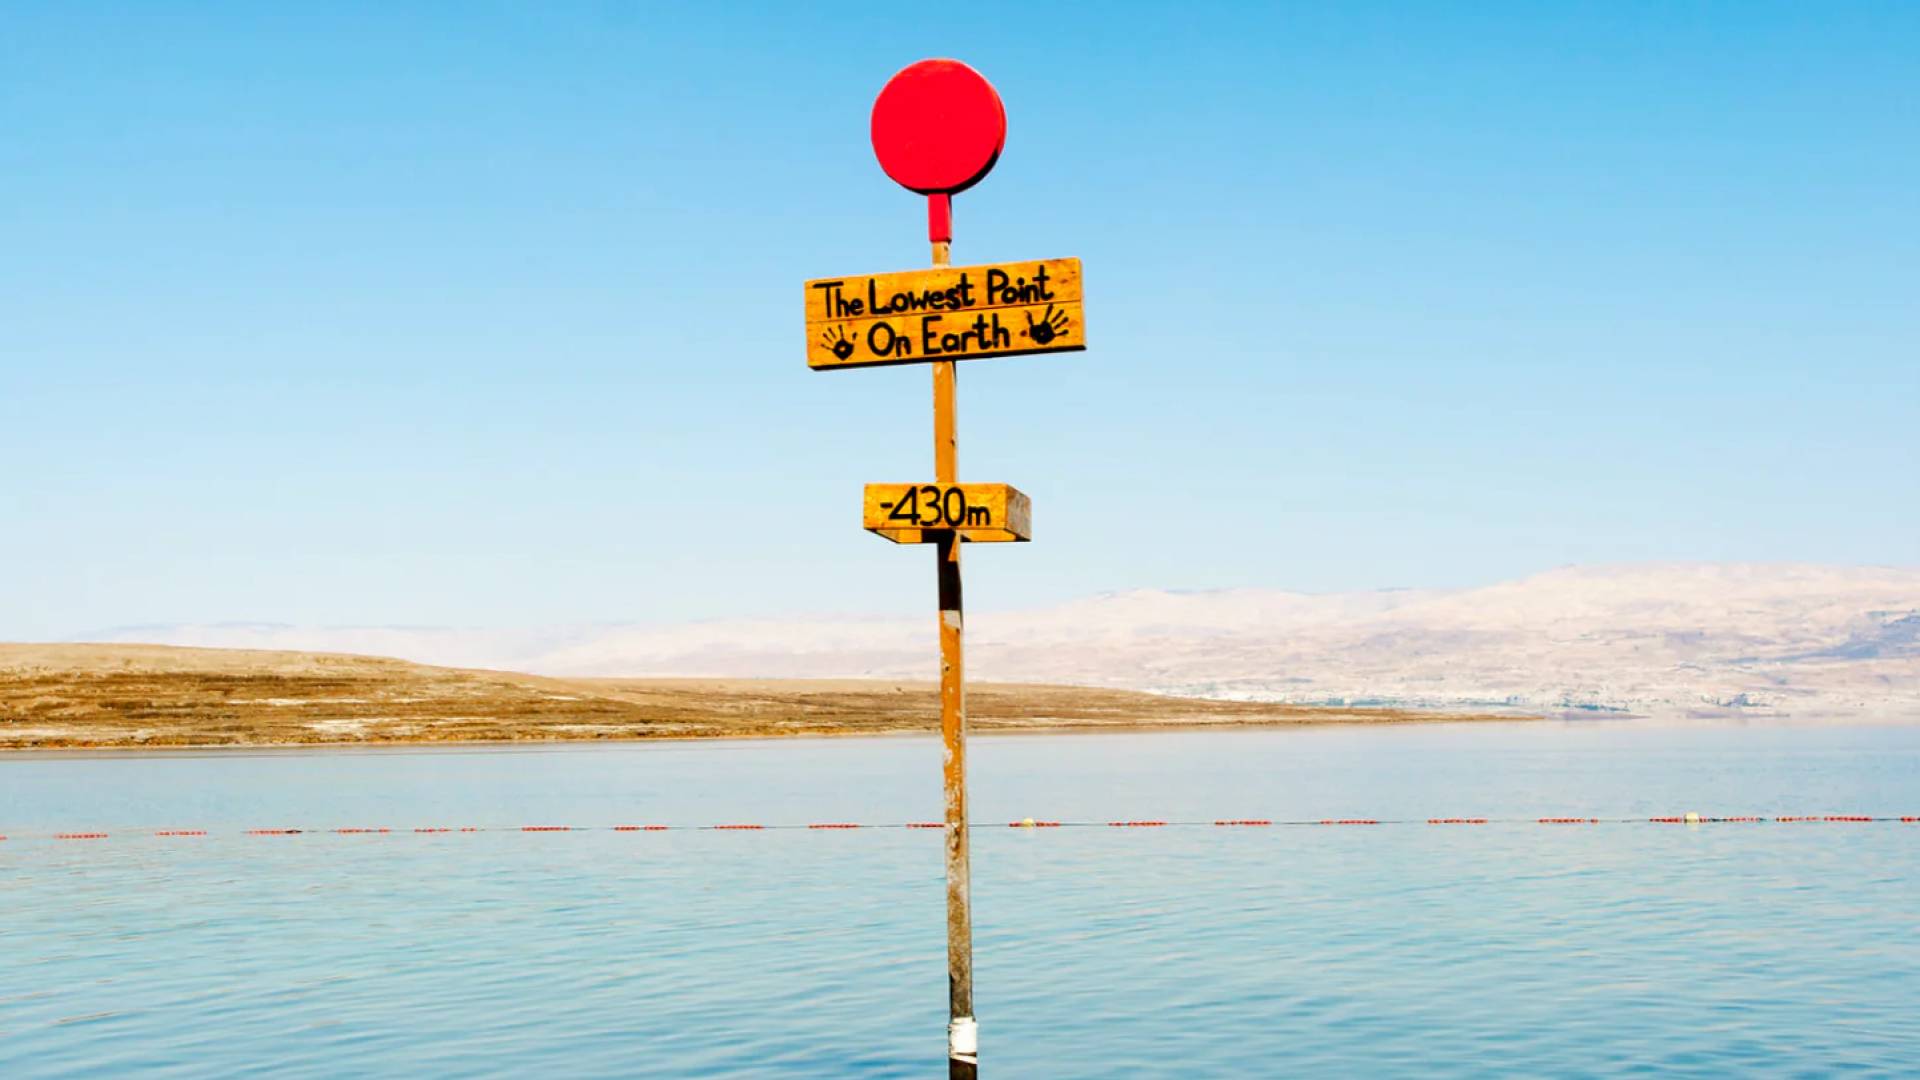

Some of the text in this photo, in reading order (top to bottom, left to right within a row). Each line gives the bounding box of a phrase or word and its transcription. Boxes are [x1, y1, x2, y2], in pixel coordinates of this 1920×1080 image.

[813, 265, 1054, 318] The Lowest Point
[867, 313, 1010, 357] On Earth
[880, 485, 991, 526] -430m
